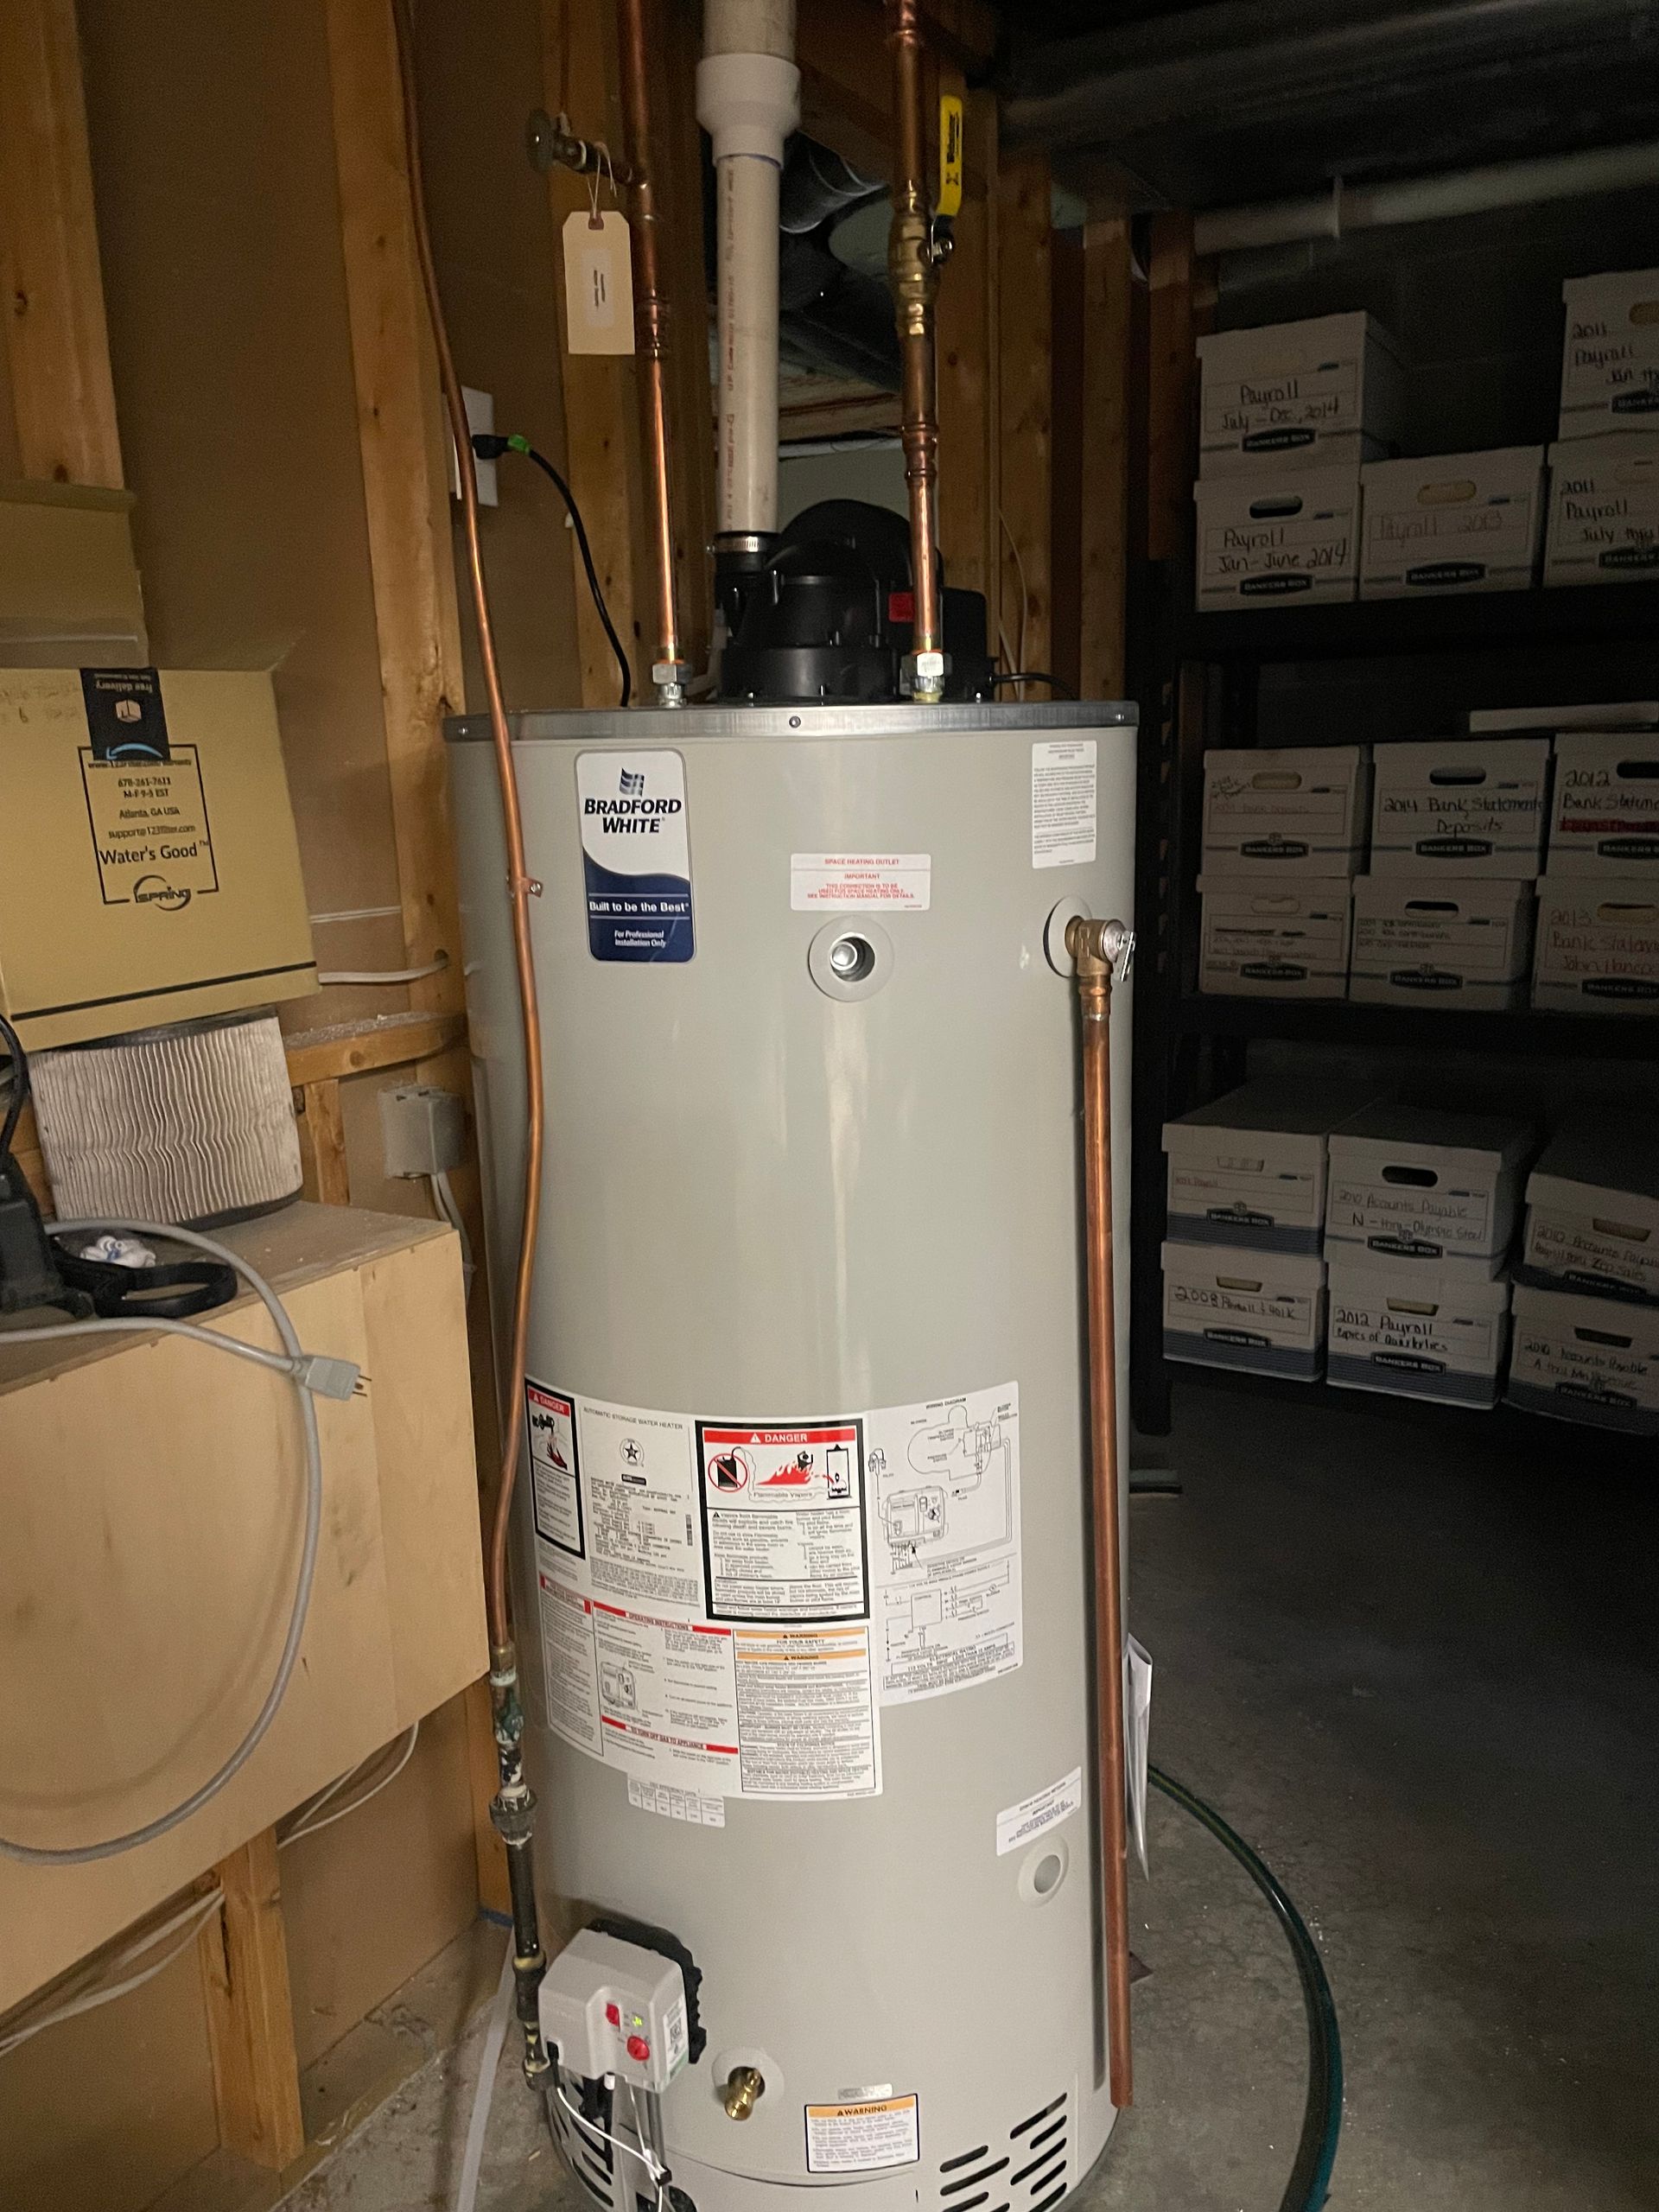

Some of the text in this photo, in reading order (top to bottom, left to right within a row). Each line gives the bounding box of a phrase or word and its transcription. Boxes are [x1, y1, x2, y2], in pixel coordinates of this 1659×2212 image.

[1241, 380, 1299, 407] Payroll
[1222, 397, 1338, 433] July 2014
[1567, 499, 1628, 522] Payroll
[1224, 527, 1284, 553] Payroll
[1584, 526, 1614, 543] July
[1264, 551, 1300, 569] June
[1306, 537, 1346, 569] 2014
[1566, 769, 1610, 787] 2012
[156, 788, 168, 797] EST
[584, 798, 682, 815] BRADFORD
[1383, 798, 1418, 813] 2014
[1428, 796, 1467, 818] Bank
[1563, 793, 1601, 810] Bank
[163, 807, 180, 816] USA
[602, 817, 661, 833] WHITE
[1437, 817, 1503, 837] Deposits
[99, 842, 198, 865] Water's Good
[1421, 843, 1487, 853] BANKERS BOX
[588, 900, 610, 912] Built
[612, 902, 622, 912] to
[624, 901, 638, 912] be
[640, 901, 657, 912] the
[614, 929, 664, 939] For Professional
[614, 938, 667, 949] Installation Only
[1367, 1192, 1414, 1211] Accounts
[1421, 1199, 1467, 1219] Payable
[1352, 1212, 1363, 1225] N
[1372, 1241, 1415, 1253] BANKERS
[1174, 1287, 1217, 1307] 2008
[1336, 1309, 1433, 1337] 2012 Payroll
[1369, 1331, 1381, 1344] of
[539, 1395, 566, 1414] DANGER
[583, 1407, 683, 1430] AUTOMATIC STORAGE WATER HEATER
[764, 1433, 808, 1443] DANGER
[628, 1612, 653, 1626] OPERATING
[677, 1738, 704, 1750] APPLIANCE
[844, 2106, 887, 2116] WARNING
